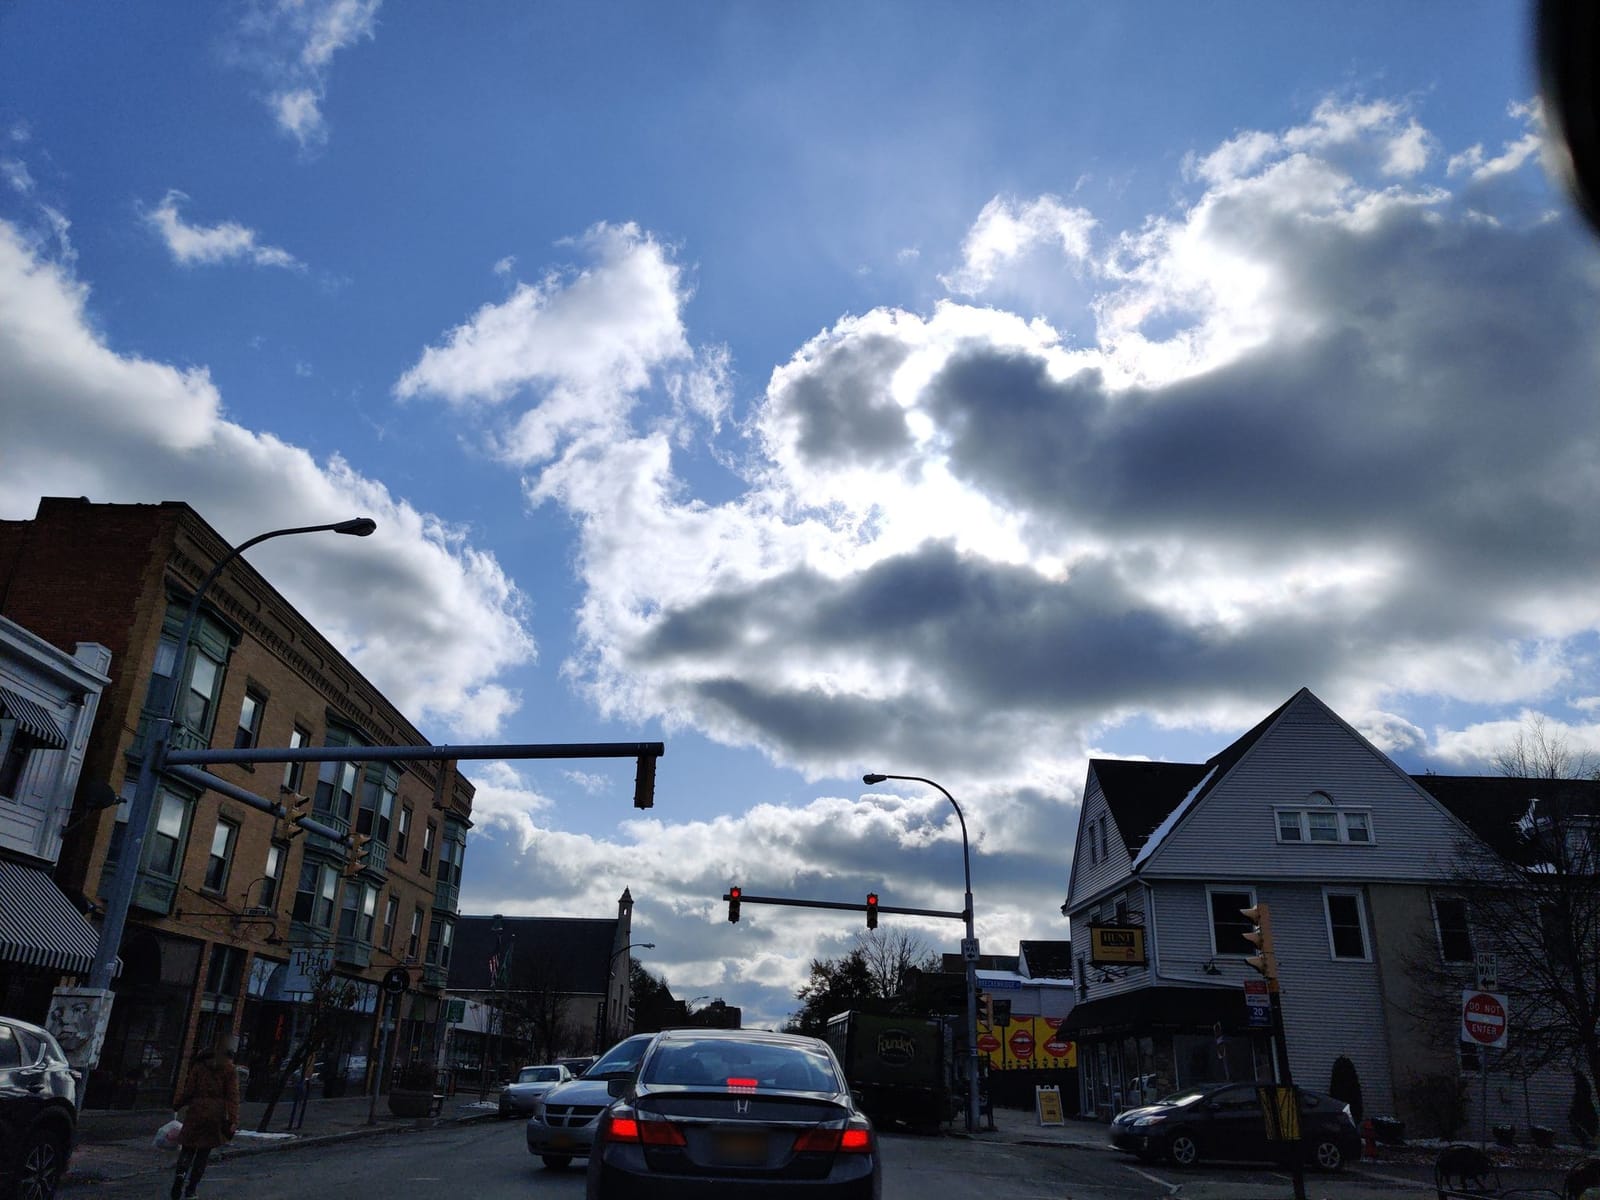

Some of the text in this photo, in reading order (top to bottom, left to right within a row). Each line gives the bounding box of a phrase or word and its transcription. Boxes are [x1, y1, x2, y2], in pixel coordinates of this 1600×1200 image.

[1102, 932, 1134, 944] HUNT
[291, 951, 329, 968] Thin
[1478, 954, 1496, 965] ONE
[300, 961, 322, 976] Ice
[1478, 966, 1496, 976] WAY
[1253, 1007, 1264, 1017] 20
[1469, 1002, 1502, 1014] DO NOT
[1471, 1023, 1497, 1035] ENTER
